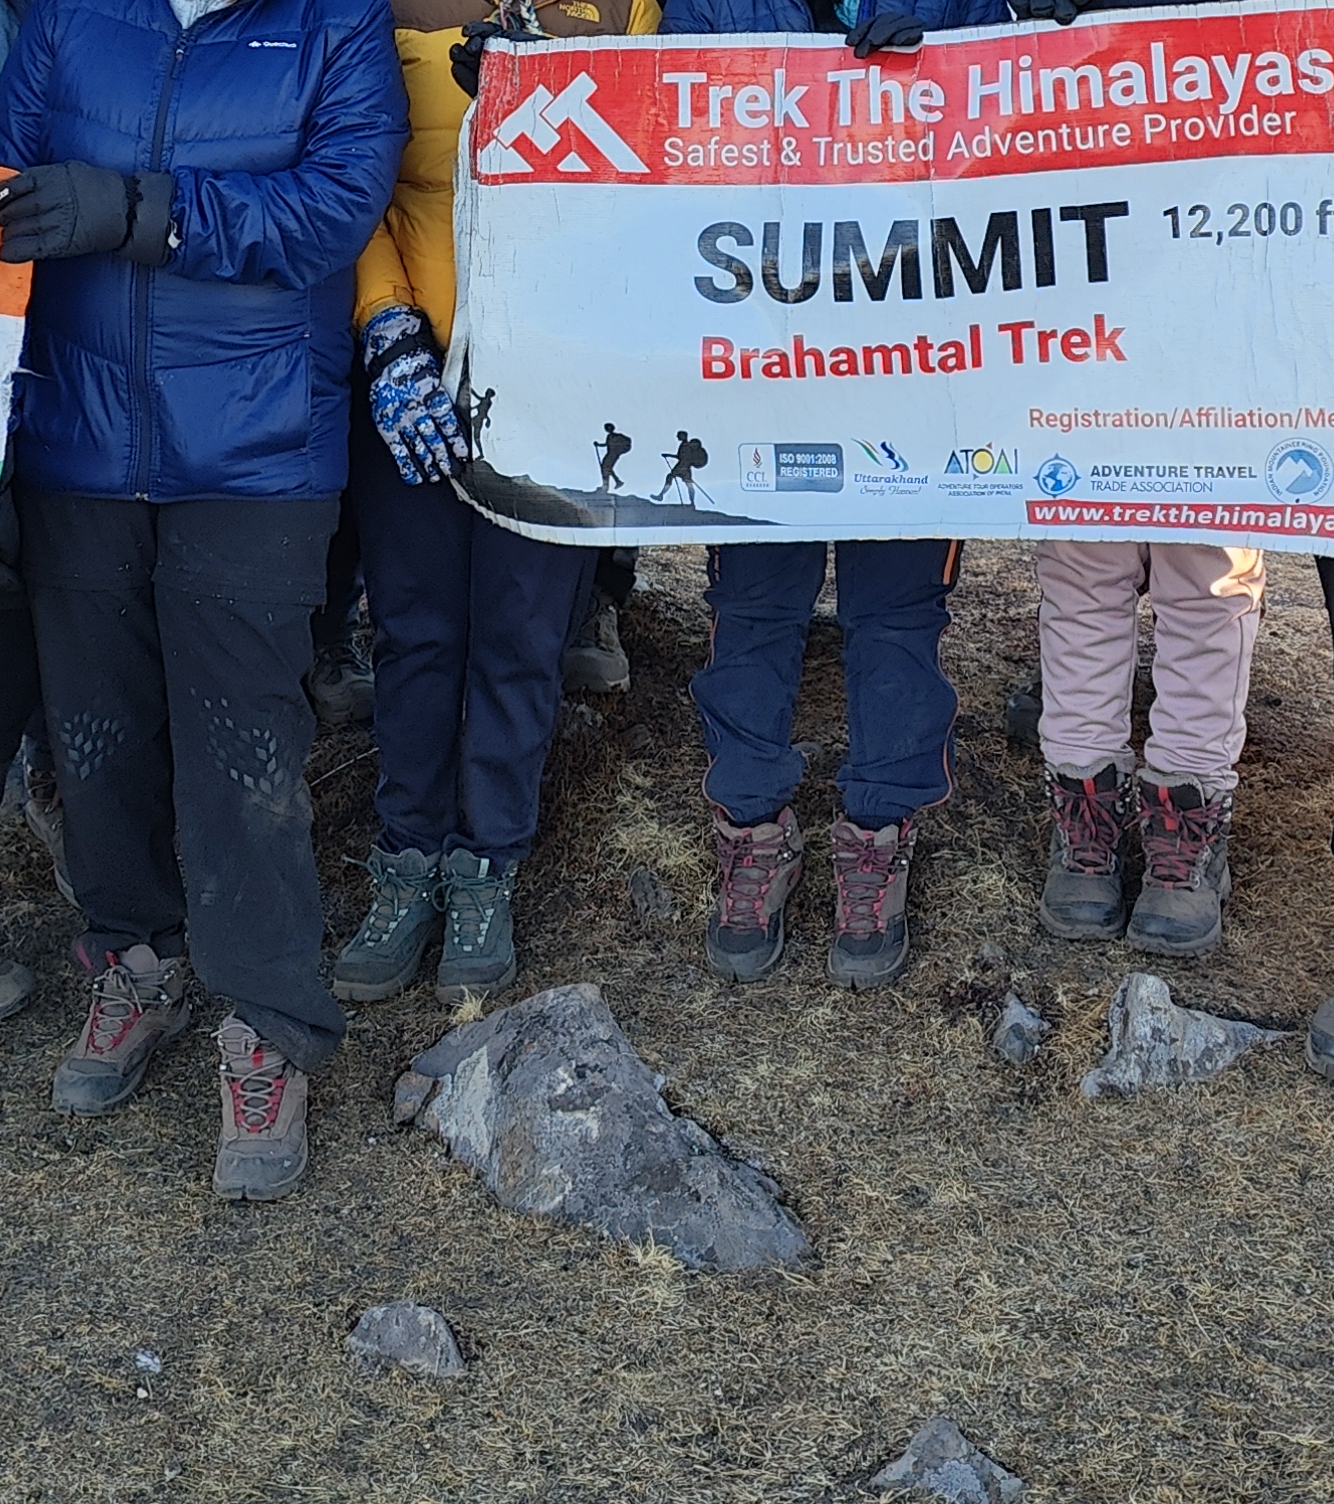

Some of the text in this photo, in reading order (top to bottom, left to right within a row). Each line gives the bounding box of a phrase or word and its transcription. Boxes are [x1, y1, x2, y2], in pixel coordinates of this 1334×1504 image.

[662, 68, 810, 128] Trek
[827, 64, 945, 126] The
[663, 104, 1297, 168] Safest & Trusted Adventure Provider
[693, 200, 1130, 304] SUMMIT
[1163, 201, 1303, 245] 12,200
[699, 314, 1128, 381] Brahamtal Trek
[779, 453, 795, 465] ISO
[746, 471, 768, 483] CCL
[780, 466, 839, 478] REGISTERED
[1090, 464, 1258, 479] ADVENTURE TRAVEL
[853, 473, 929, 485] Uttarakhand
[1090, 480, 1214, 494] TRADE ASSOCIATION
